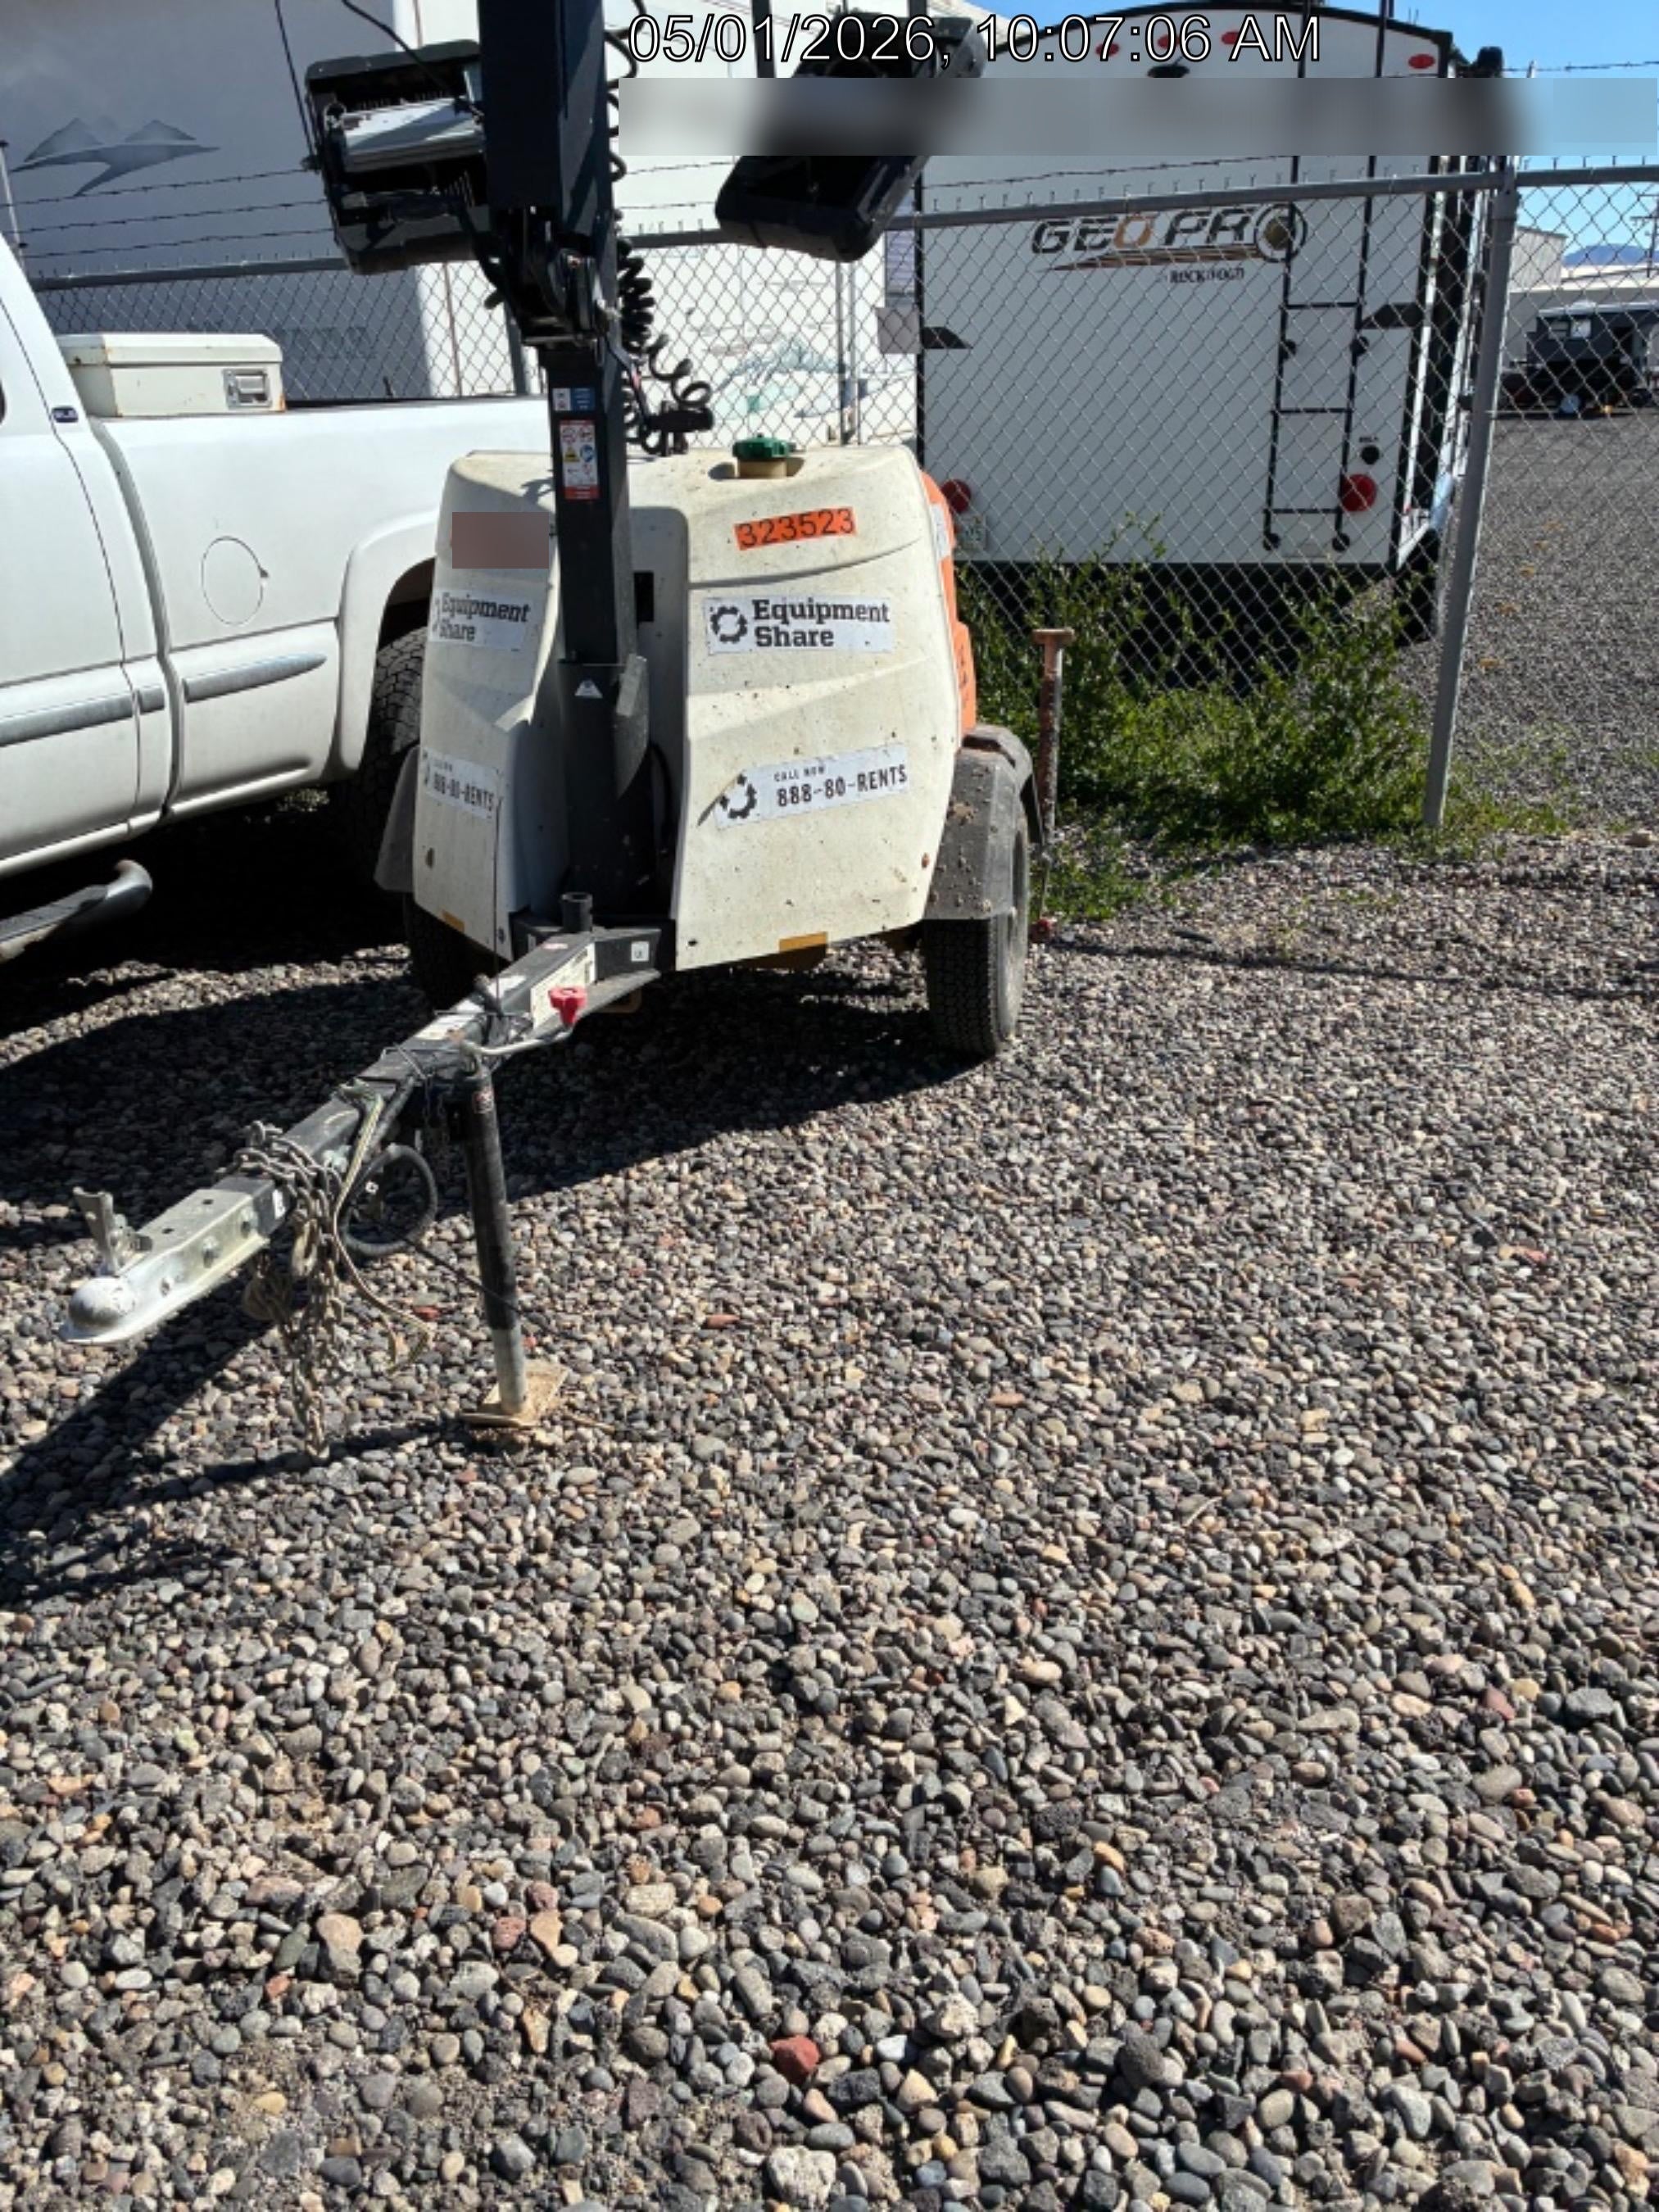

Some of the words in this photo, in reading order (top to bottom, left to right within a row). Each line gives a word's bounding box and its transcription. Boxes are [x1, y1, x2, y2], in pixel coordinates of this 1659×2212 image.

[1031, 211, 1160, 255] GEO
[738, 508, 855, 548] 323523
[441, 592, 531, 623] Equipment
[751, 597, 891, 625] Equipment
[439, 618, 476, 641] Share
[754, 626, 835, 647] Share
[777, 764, 908, 808] 888-80-RENTS
